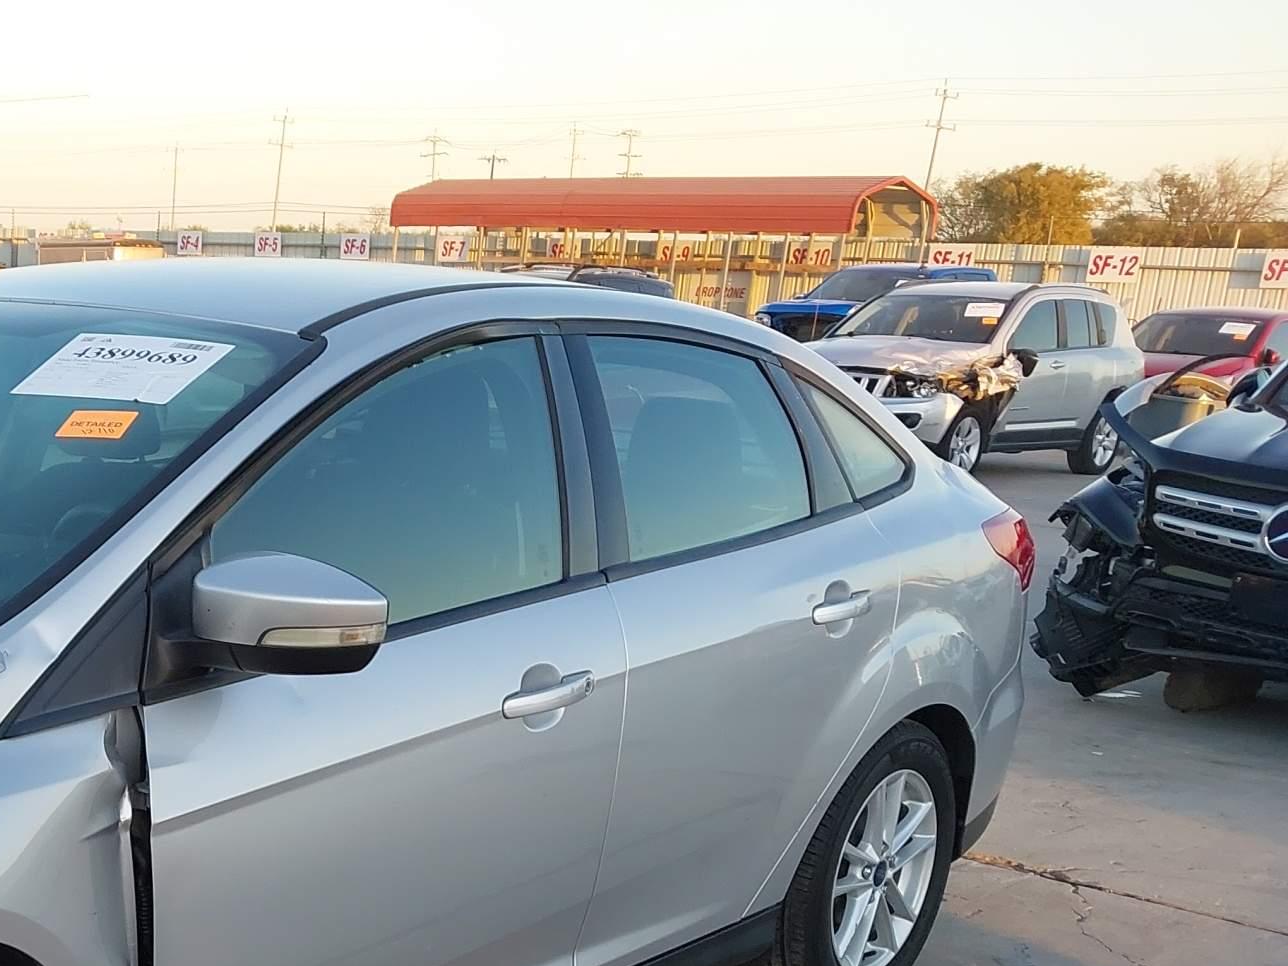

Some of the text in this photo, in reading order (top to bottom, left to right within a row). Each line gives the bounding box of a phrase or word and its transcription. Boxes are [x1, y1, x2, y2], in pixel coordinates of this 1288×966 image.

[179, 235, 200, 250] SF-4
[257, 236, 278, 252] SF-5
[343, 238, 367, 255] SF-6
[441, 240, 466, 257] SF-7
[1089, 255, 1139, 276] SF-12
[73, 346, 198, 366] 43899689
[70, 420, 123, 428] DETAILED
